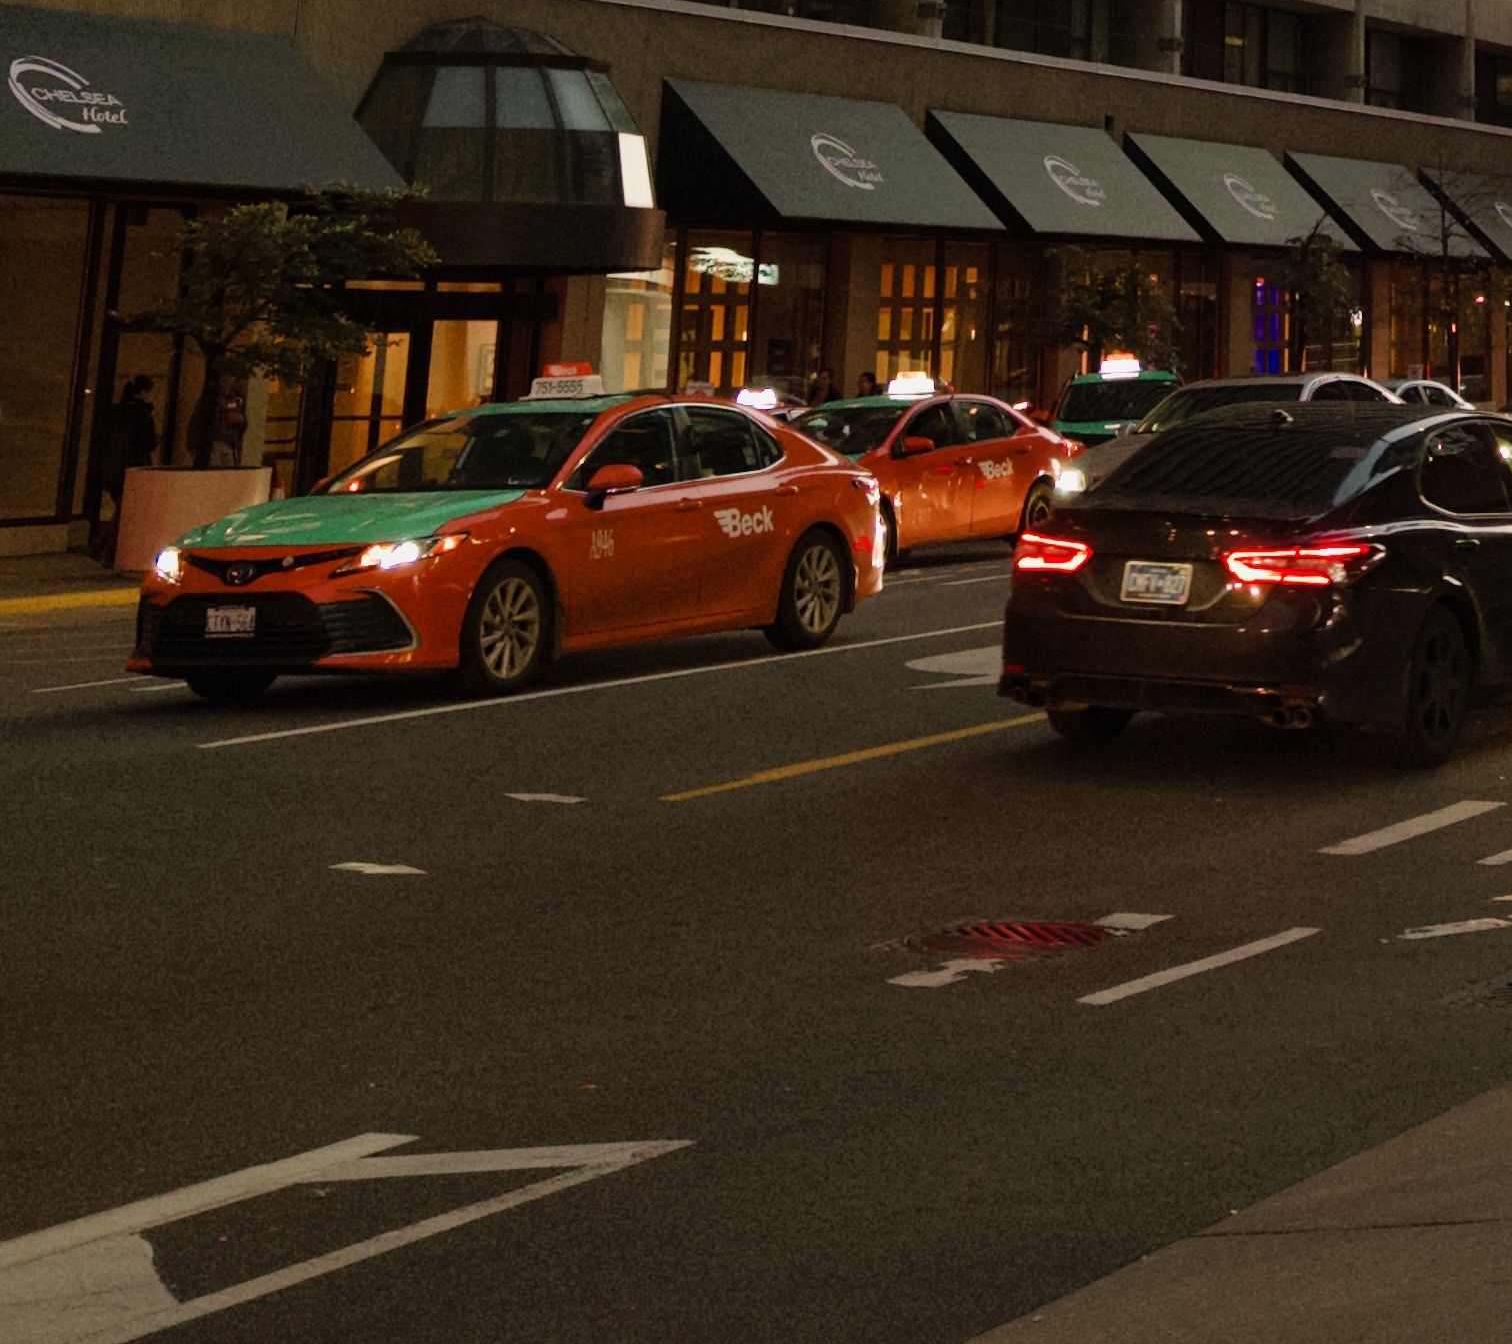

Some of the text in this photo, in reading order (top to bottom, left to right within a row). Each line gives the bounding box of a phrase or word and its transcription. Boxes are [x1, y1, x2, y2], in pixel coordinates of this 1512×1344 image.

[31, 87, 123, 106] CHELSEA
[82, 106, 128, 124] Hotel
[719, 505, 774, 538] Beck
